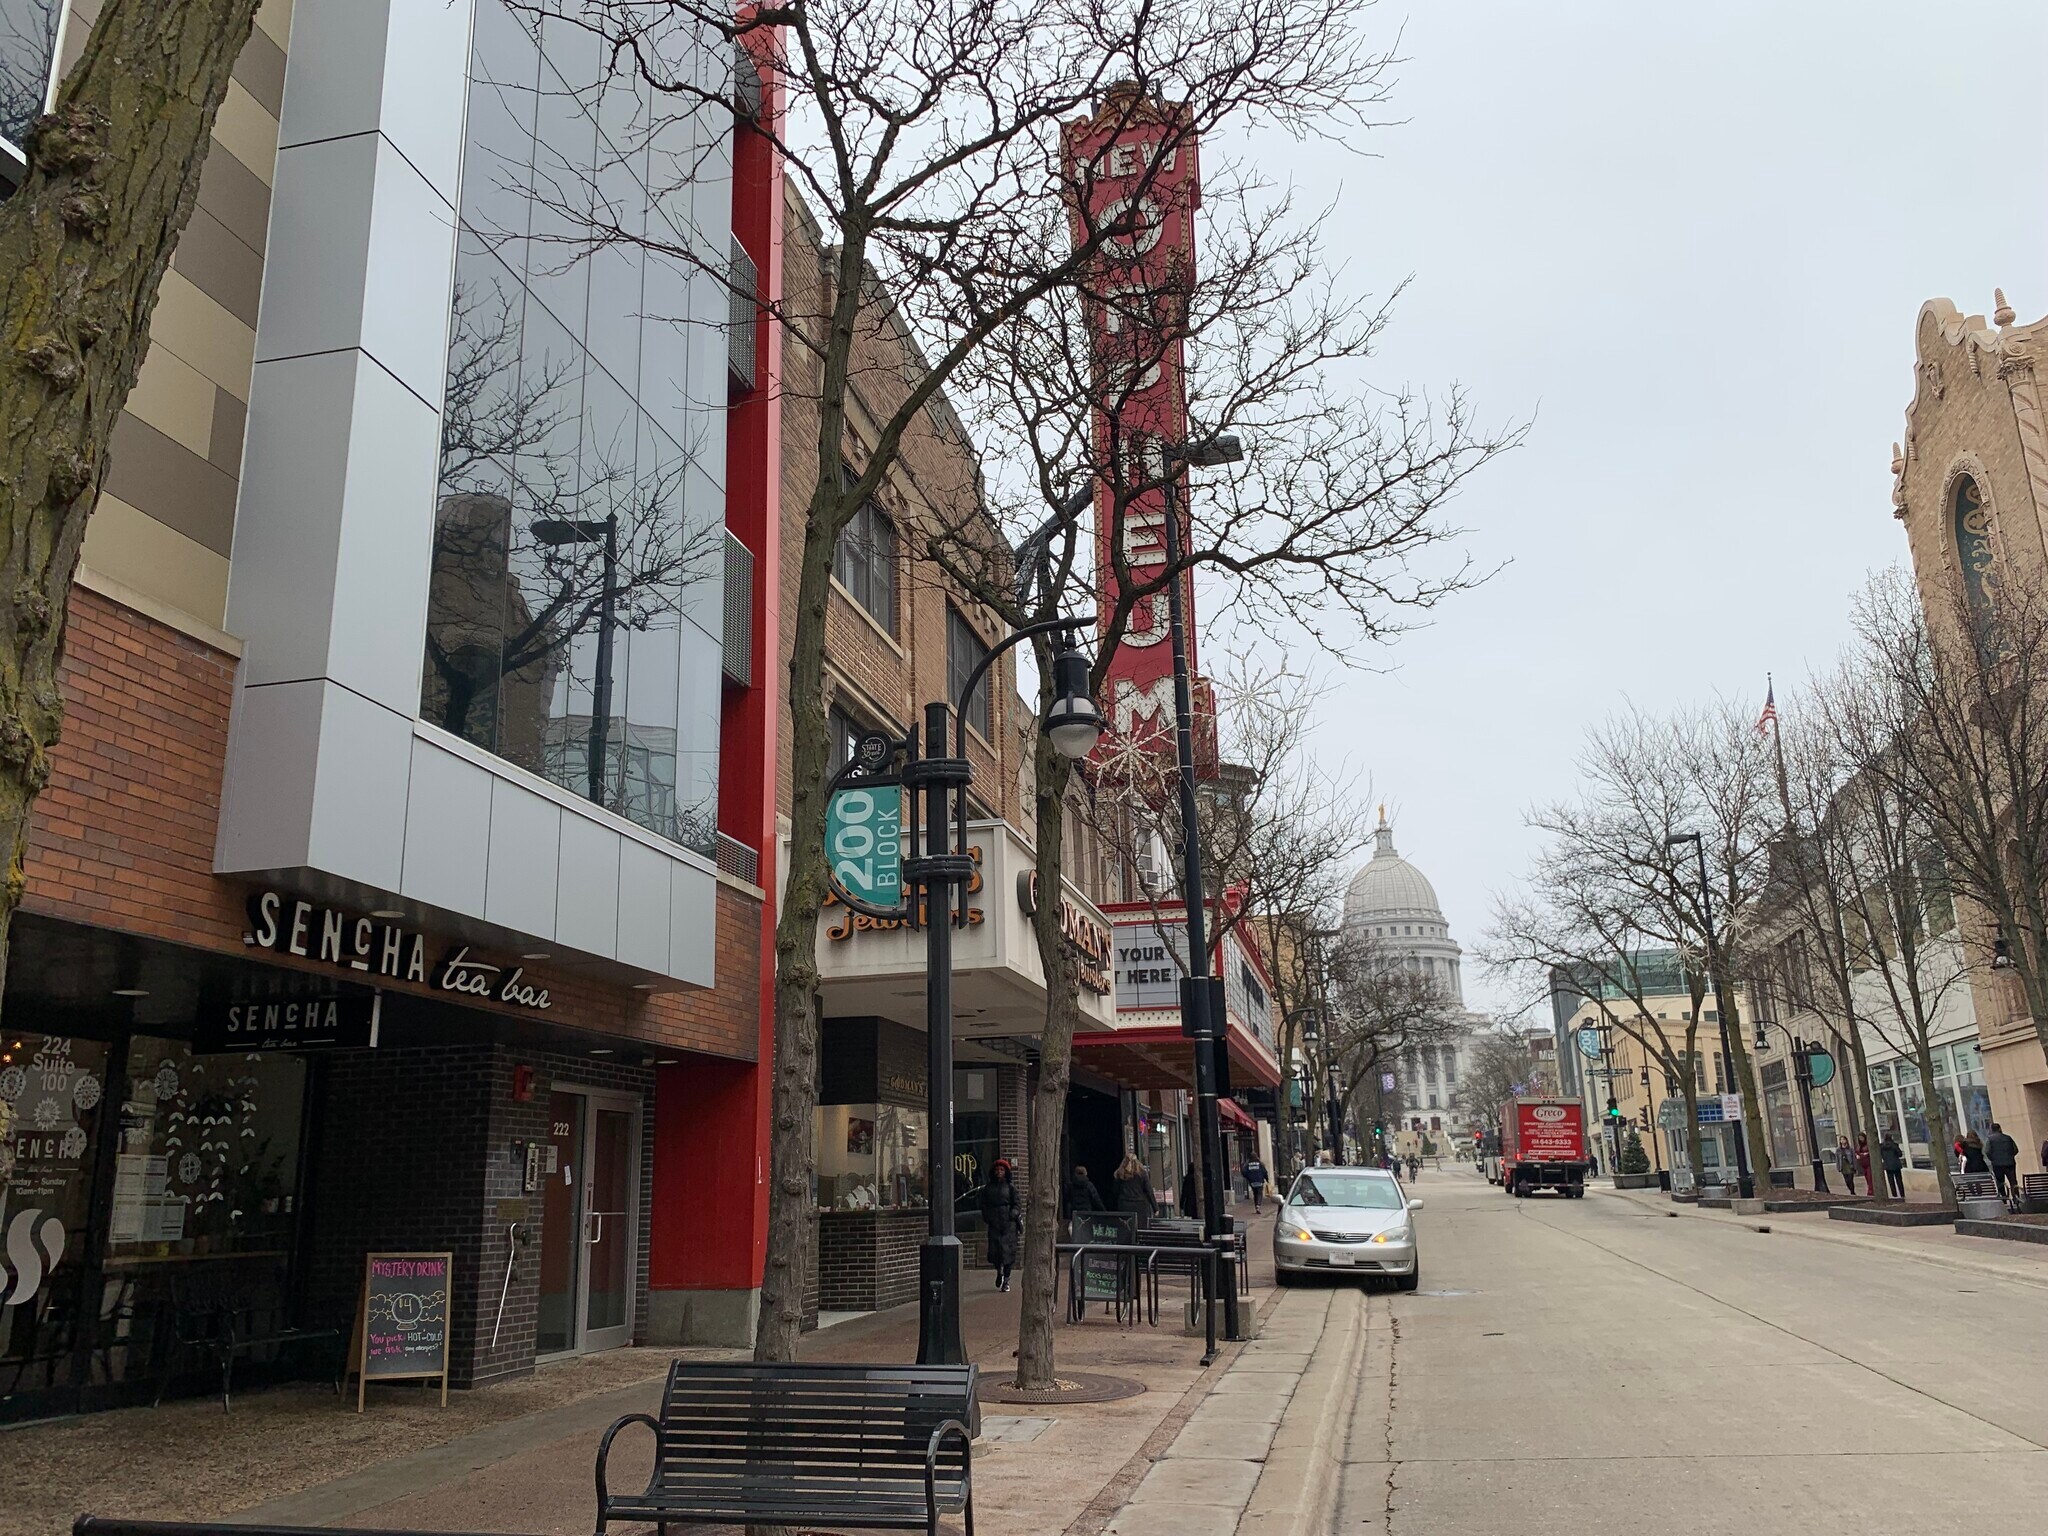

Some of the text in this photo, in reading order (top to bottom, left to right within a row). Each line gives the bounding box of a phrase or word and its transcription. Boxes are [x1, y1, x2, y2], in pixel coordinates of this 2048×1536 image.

[834, 790, 875, 891] 200
[876, 807, 898, 887] BLOCK
[256, 892, 552, 1010] SENCHA tea bar
[1118, 945, 1166, 963] YOUR
[1127, 967, 1172, 984] HERE
[227, 1000, 338, 1033] SENCHA
[41, 1035, 72, 1056] 224
[32, 1052, 76, 1075] Suite
[40, 1074, 68, 1092] 100
[1536, 1108, 1563, 1117] Greco
[553, 1122, 570, 1136] 222
[41, 1177, 67, 1187] Sunday
[372, 1262, 444, 1277] MYSTERY DRINK
[407, 1332, 422, 1342] HOT
